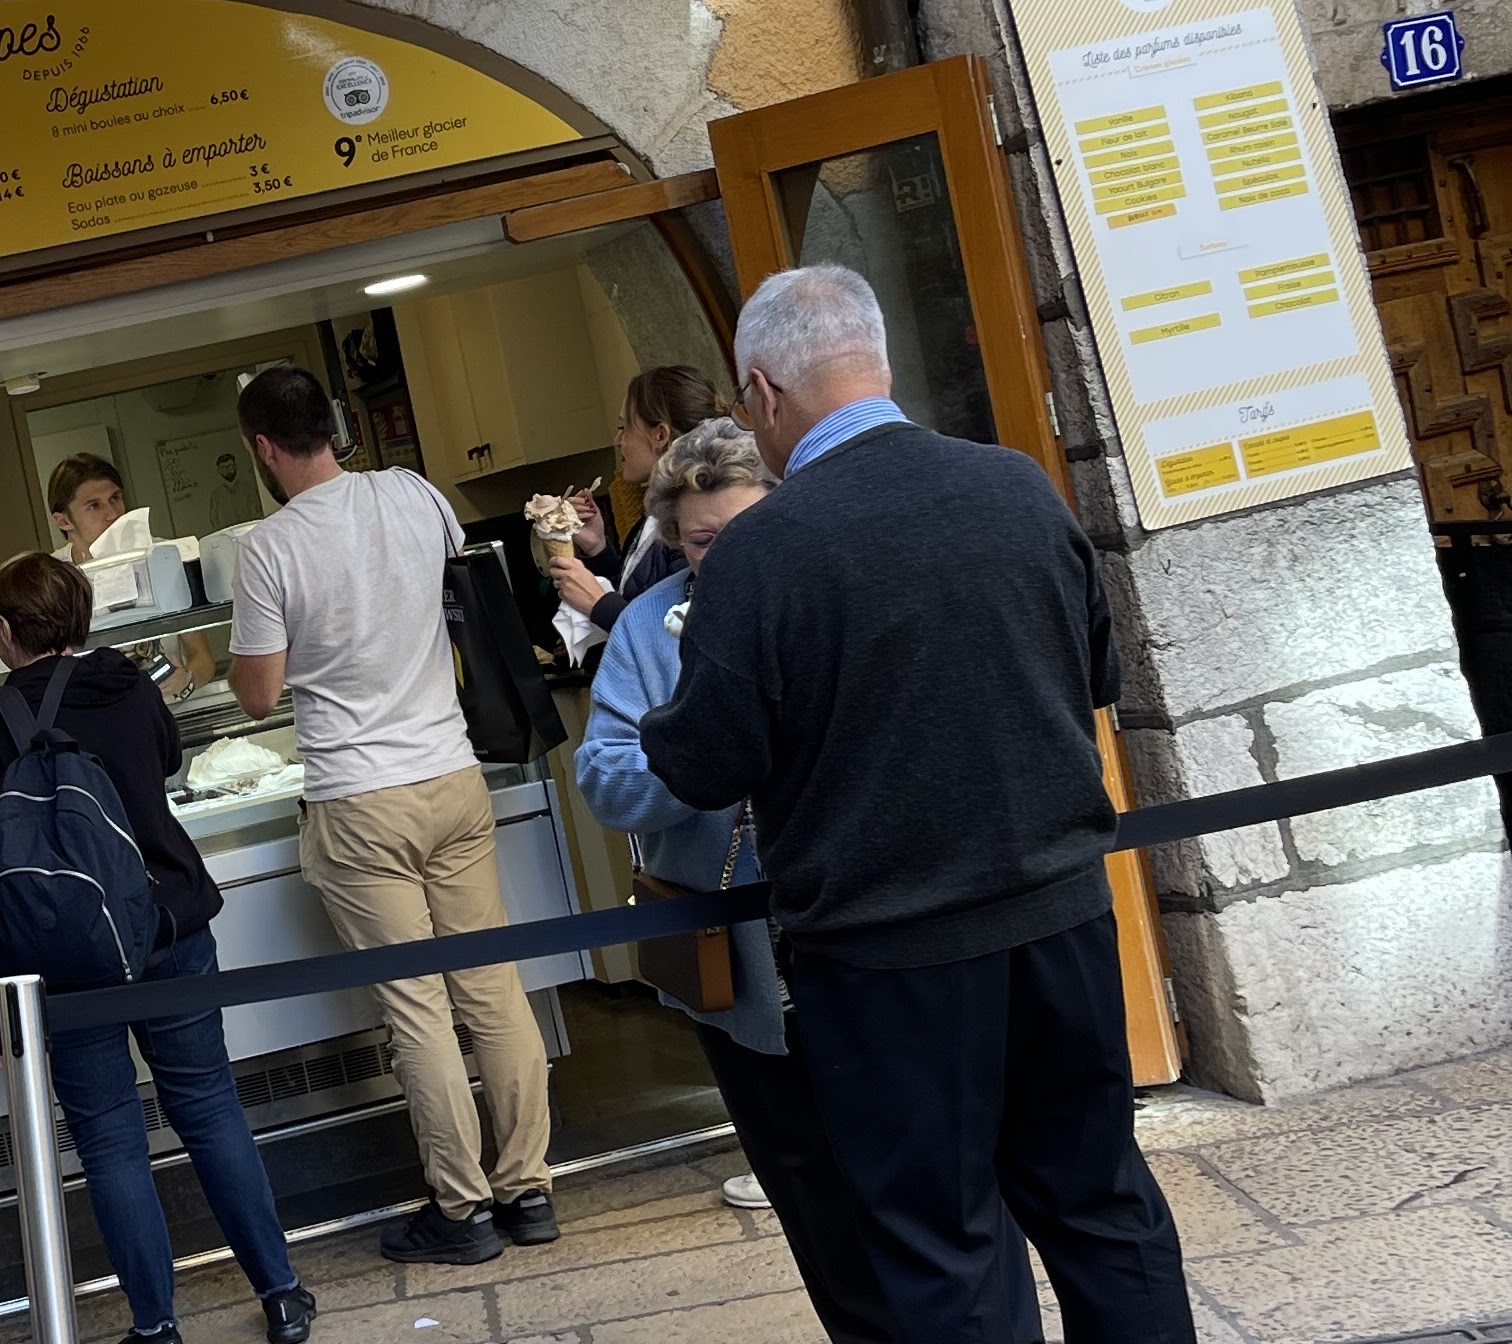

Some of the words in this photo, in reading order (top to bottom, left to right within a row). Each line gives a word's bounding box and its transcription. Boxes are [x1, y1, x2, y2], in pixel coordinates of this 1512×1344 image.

[1081, 50, 1111, 69] Liste
[1113, 47, 1131, 60] des
[1134, 36, 1181, 59] parfums
[1183, 23, 1243, 47] disponibles
[1399, 25, 1448, 76] 16
[21, 58, 74, 83] DEPUIS
[45, 74, 164, 115] Dégustation
[51, 125, 61, 138] 8
[62, 120, 88, 137] mini
[90, 113, 132, 131] boules
[133, 111, 151, 123] au
[152, 101, 186, 119] choix
[366, 122, 421, 146] Meilleur
[422, 115, 468, 139] glacier
[1206, 128, 1241, 141] Caramel
[62, 153, 155, 189] Boissons
[162, 146, 176, 169] à
[182, 131, 267, 168] emporter
[371, 148, 388, 164] de
[390, 138, 439, 159] France
[67, 200, 93, 215] Eau
[94, 192, 128, 213] plate
[129, 189, 146, 202] ou
[147, 179, 199, 202] gazeuse
[1124, 193, 1159, 206] Cookies
[71, 214, 111, 231] Sodas
[1153, 289, 1181, 302] Citron
